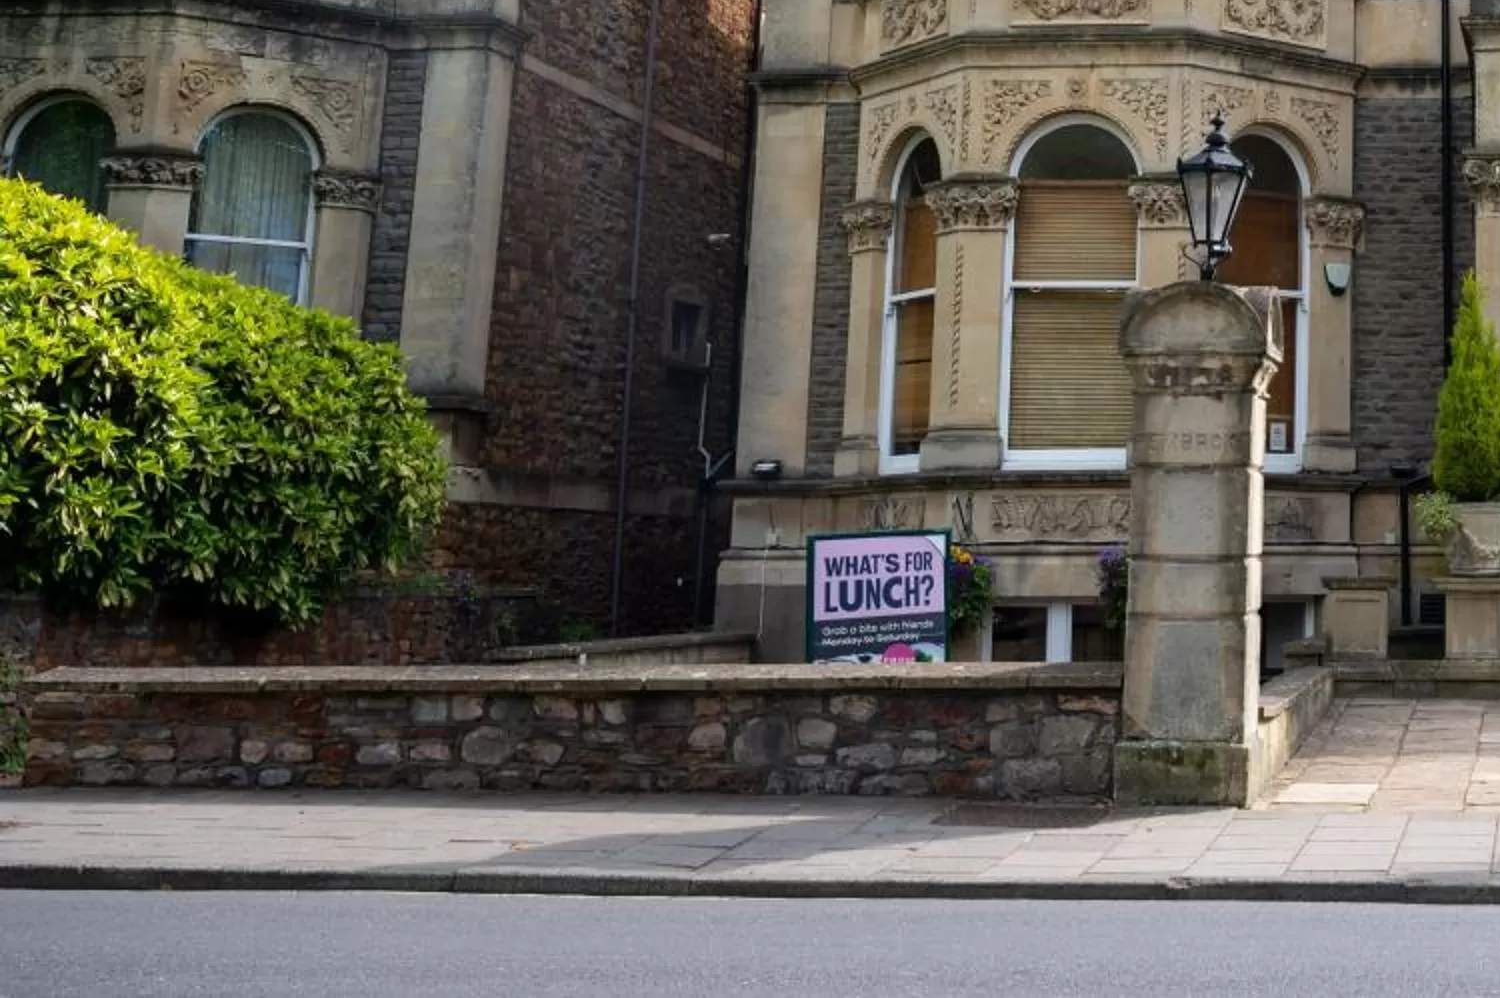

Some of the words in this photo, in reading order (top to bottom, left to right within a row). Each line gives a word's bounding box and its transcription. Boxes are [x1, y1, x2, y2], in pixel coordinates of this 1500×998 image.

[824, 553, 900, 576] WHAT'S
[905, 551, 933, 571] FOR
[824, 575, 934, 612] LUNCH?
[822, 626, 848, 636] Grab
[850, 626, 858, 635] a
[859, 623, 878, 634] bite
[880, 620, 901, 632] with
[902, 618, 934, 631] friends
[822, 637, 863, 647] Monday
[864, 635, 875, 643] to
[876, 631, 920, 643] Saturday
